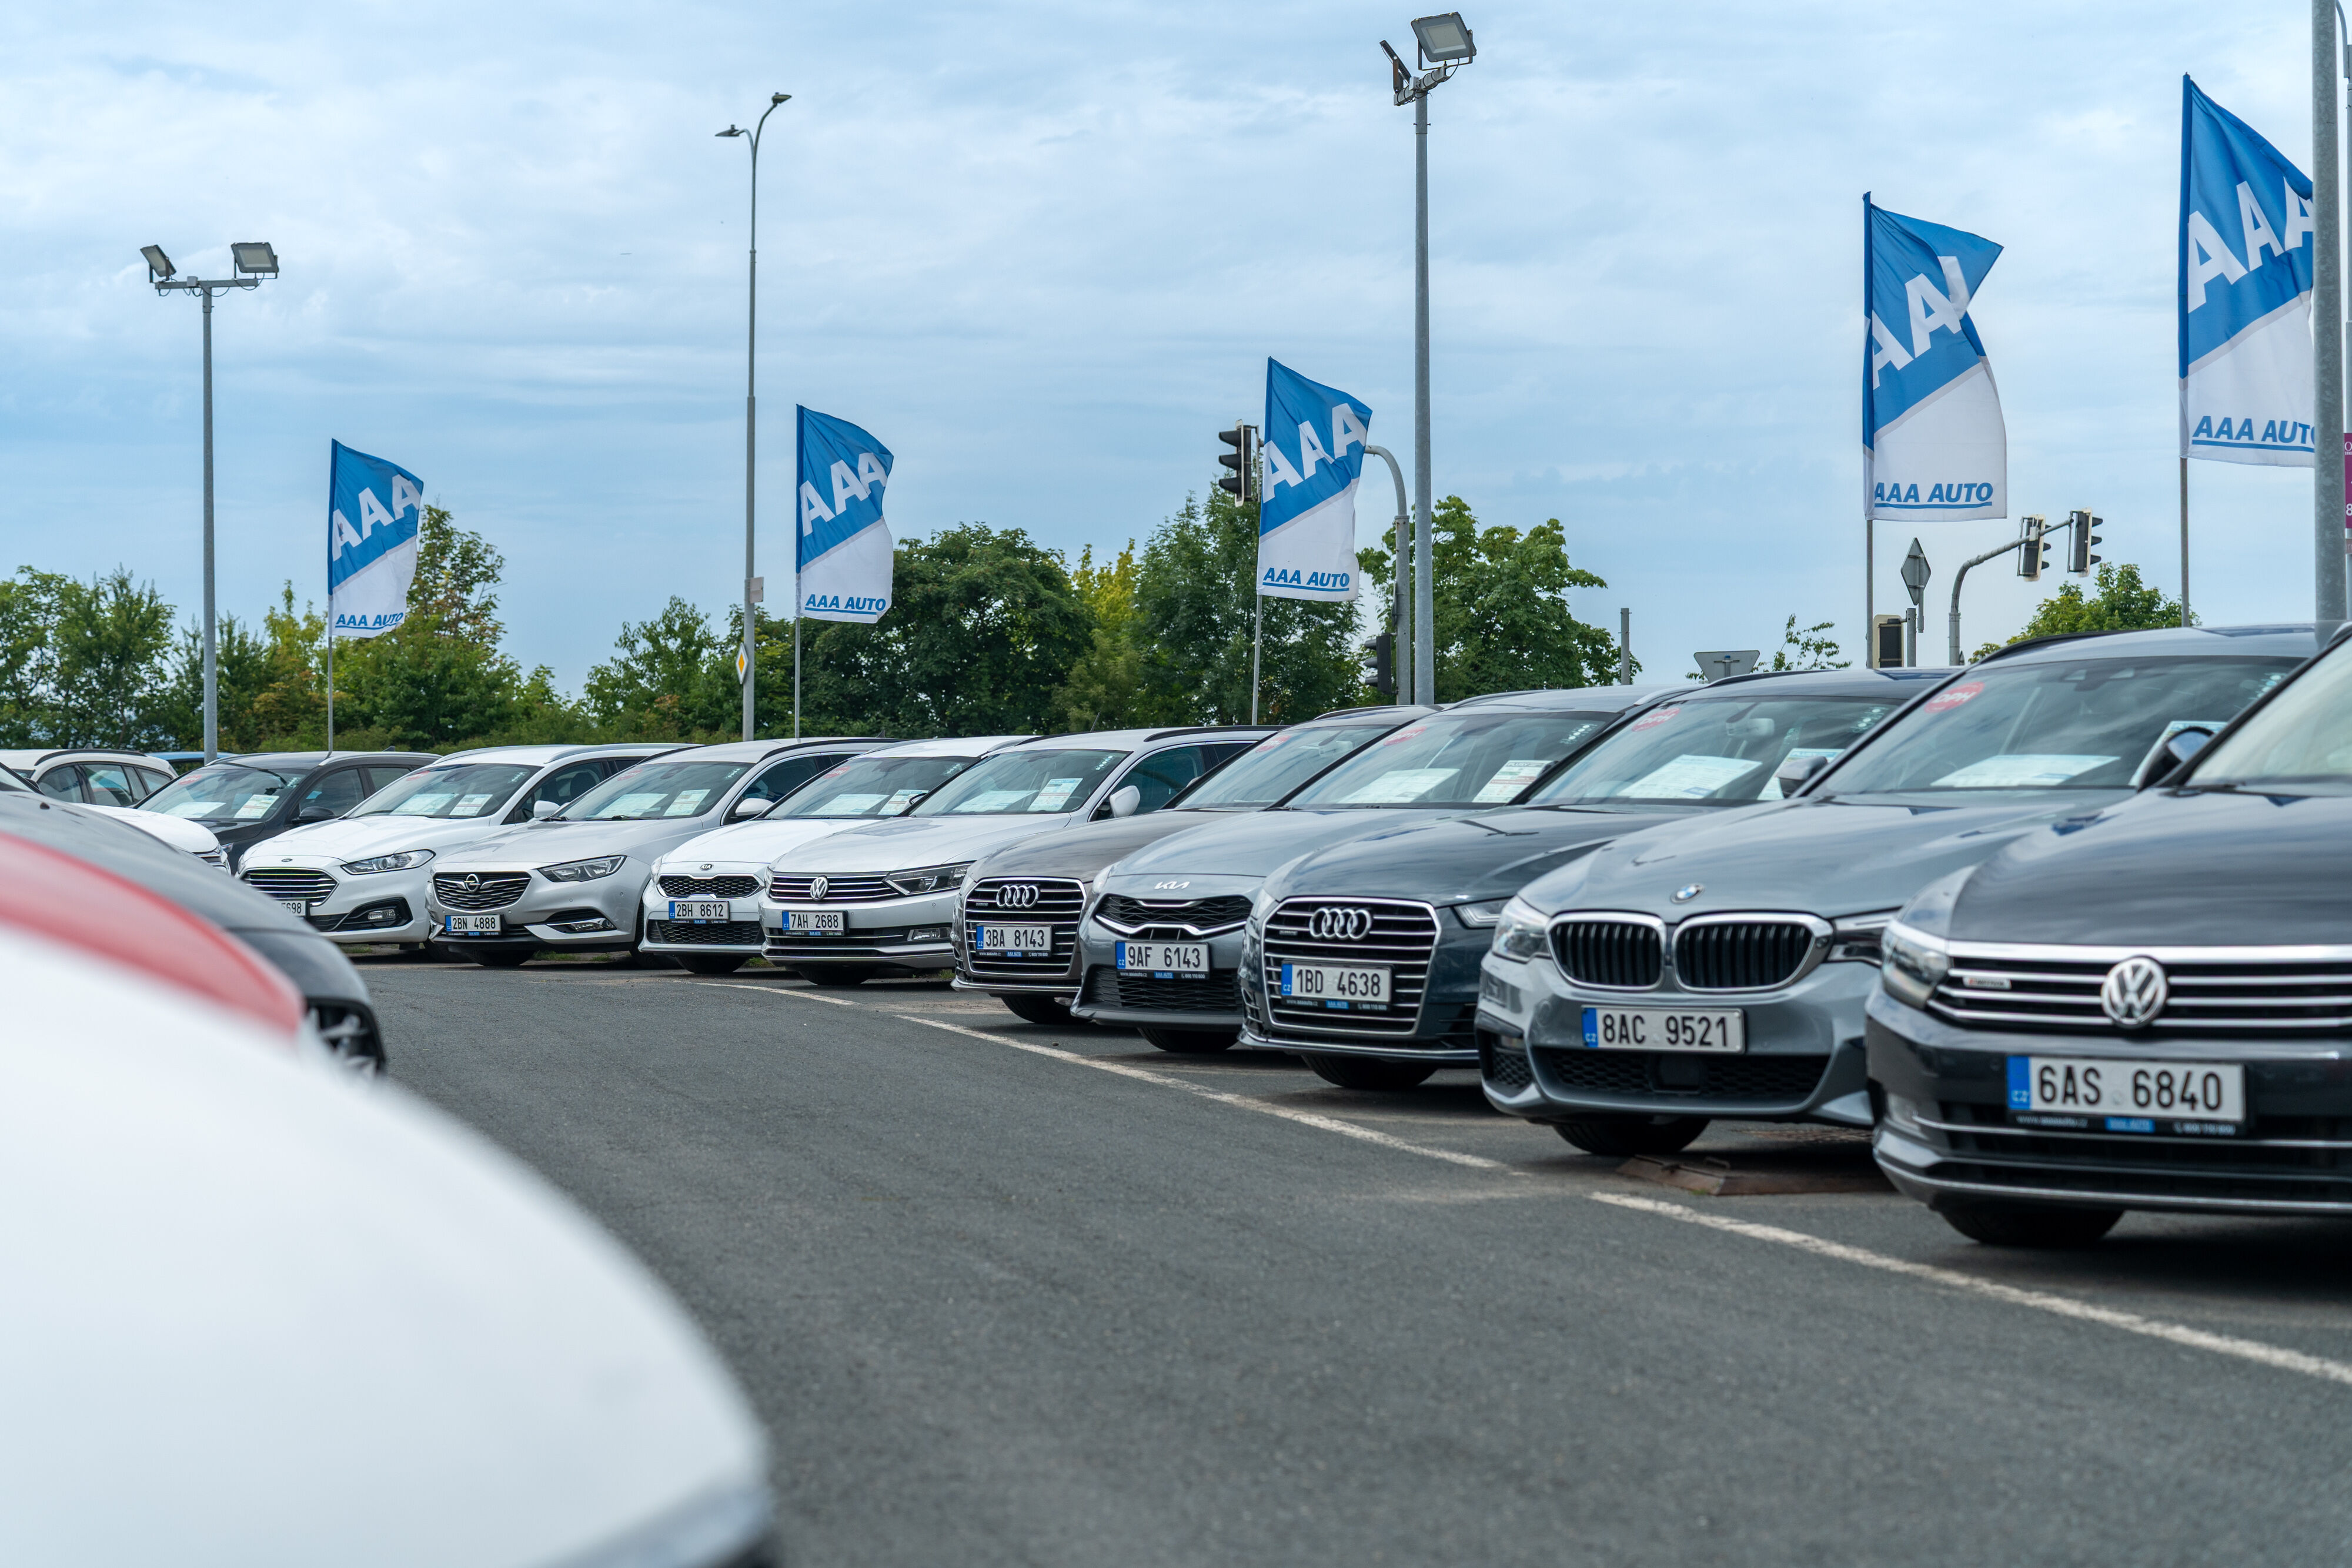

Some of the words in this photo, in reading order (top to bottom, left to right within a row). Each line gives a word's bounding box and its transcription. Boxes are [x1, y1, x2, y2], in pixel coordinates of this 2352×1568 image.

[2192, 416, 2254, 441] AAA
[2261, 420, 2315, 446] AUT
[1262, 403, 1367, 504] AAA
[799, 452, 888, 537] AAA
[1875, 482, 1920, 503] AAA
[1927, 482, 1993, 503] AUTO
[332, 474, 422, 562] AAA
[1263, 567, 1301, 584] AAA
[1307, 572, 1350, 587] AUTO
[806, 594, 840, 609] AAA
[844, 596, 886, 611] AUTO
[336, 614, 368, 626] AAA
[372, 612, 404, 626] AUTO
[677, 904, 693, 917] 2BH
[700, 904, 723, 917] 8612
[791, 914, 808, 928] 7AH
[815, 914, 838, 928] 2688
[453, 917, 467, 930] 2BN
[474, 917, 496, 929] 4888
[985, 929, 1005, 947] 3BA
[1014, 930, 1044, 947] 8143
[1128, 946, 1152, 967] 9AF
[1164, 947, 1200, 968] 6143
[1297, 969, 1323, 994] 1BD
[1337, 971, 1381, 997] 4638
[1585, 1033, 1598, 1043] CZ
[1602, 1014, 1646, 1045] 8AC
[1665, 1015, 1728, 1047] 9521
[2039, 1065, 2102, 1105] 6AS
[2133, 1069, 2222, 1111] 6840
